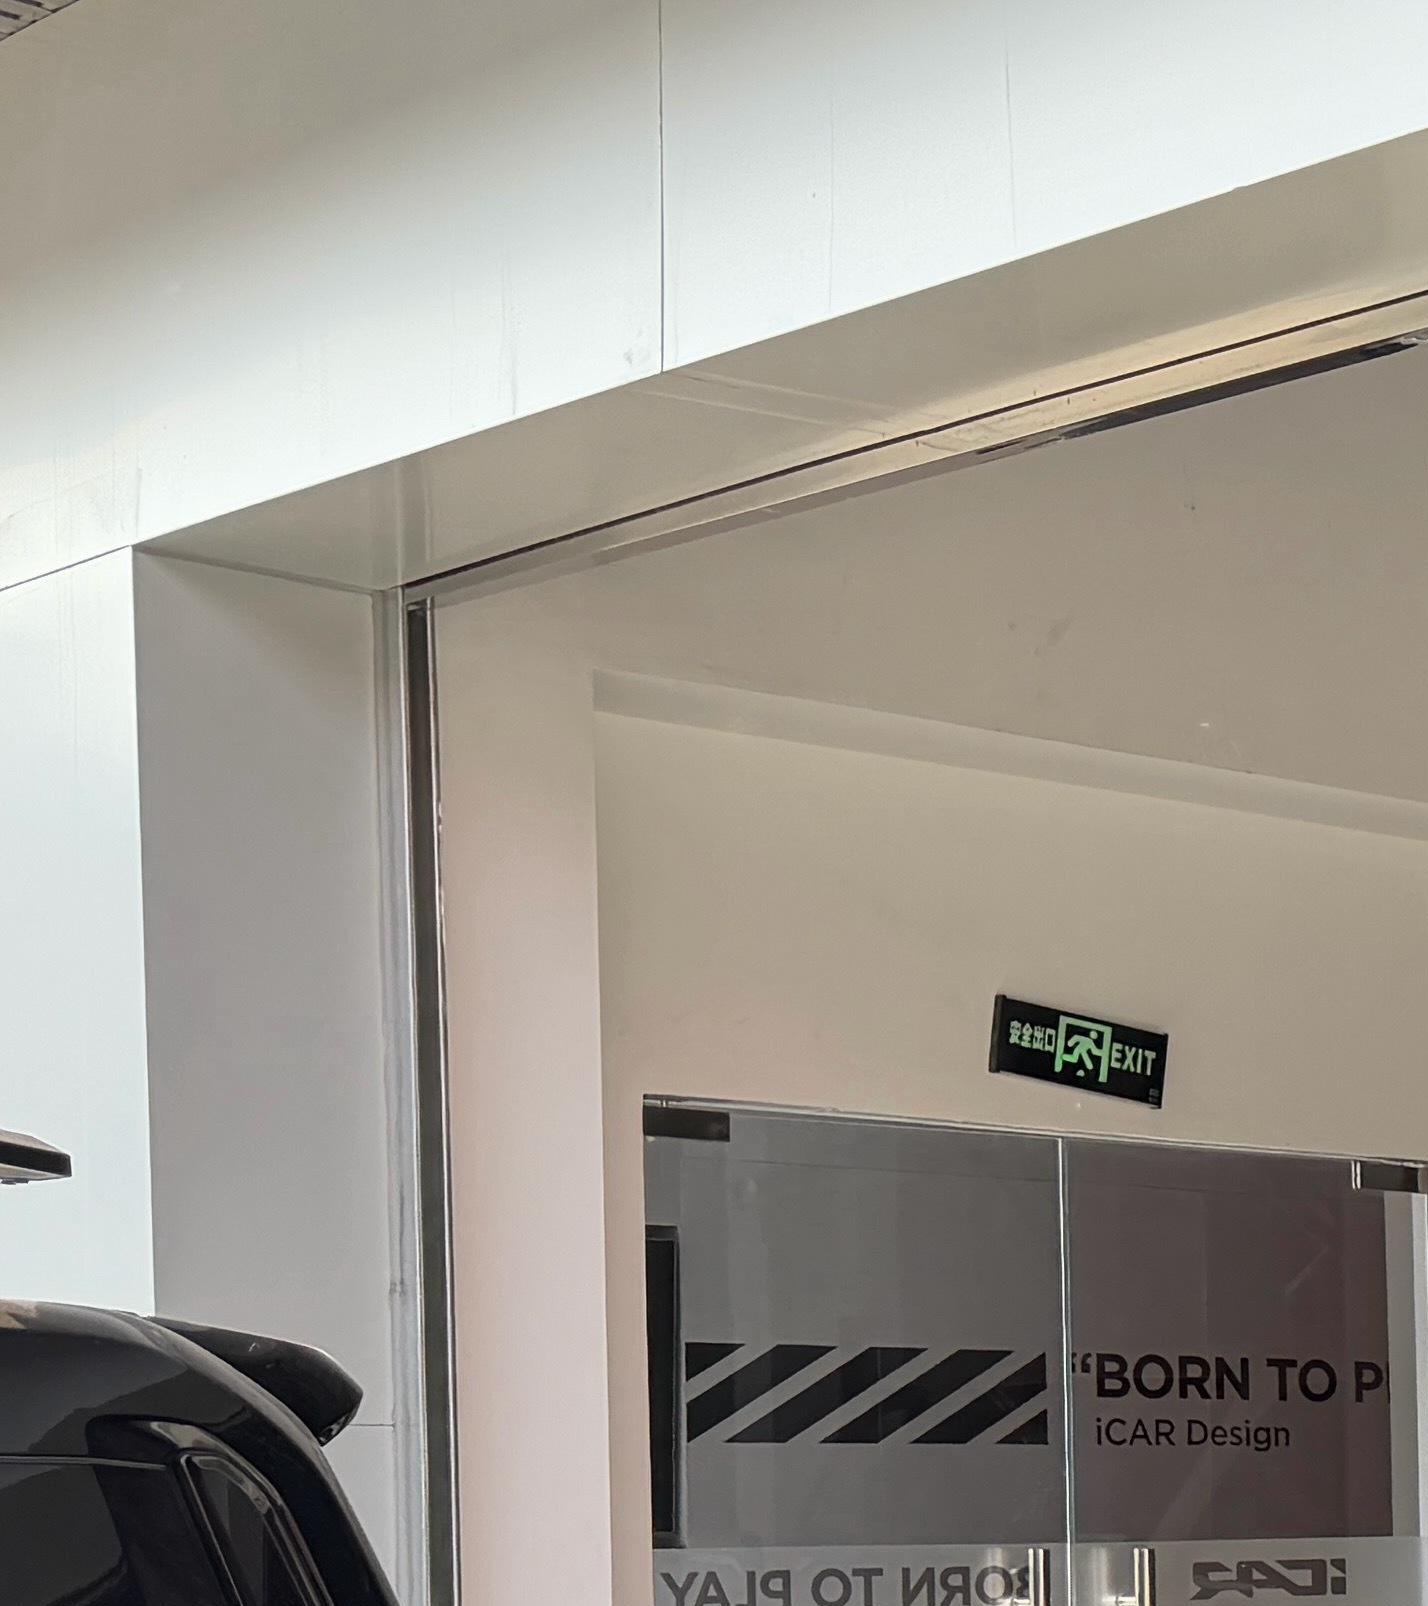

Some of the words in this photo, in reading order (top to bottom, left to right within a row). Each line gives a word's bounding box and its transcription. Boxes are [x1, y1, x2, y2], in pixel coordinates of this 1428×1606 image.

[1008, 1019, 1057, 1053] 安全出口
[1110, 1042, 1157, 1076] EXIT
[1265, 1357, 1338, 1403] TO
[1353, 1360, 1391, 1404] P
[1096, 1417, 1176, 1447] iCAR
[1187, 1419, 1291, 1452] Design
